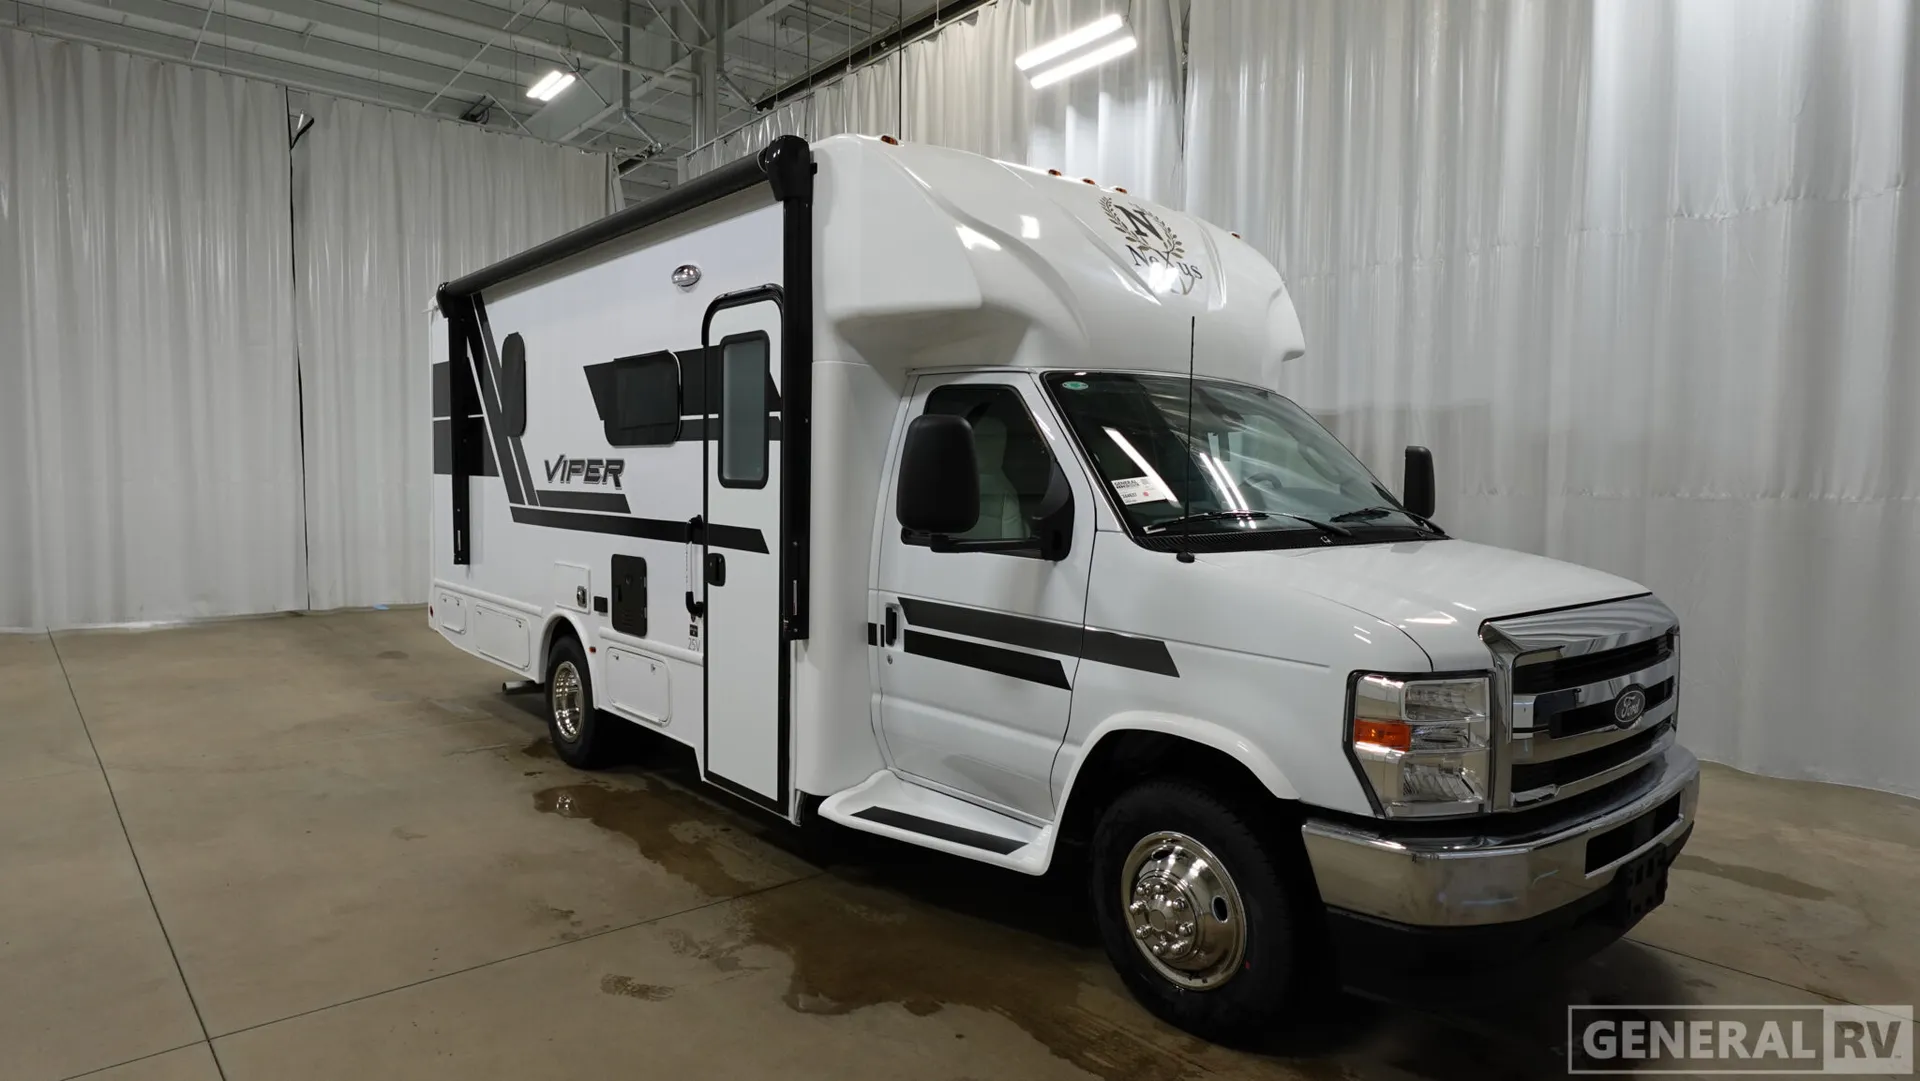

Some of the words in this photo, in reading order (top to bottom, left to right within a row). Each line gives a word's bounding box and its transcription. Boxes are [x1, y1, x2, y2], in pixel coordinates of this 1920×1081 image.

[1113, 204, 1164, 241] N
[543, 454, 625, 490] VIPER
[1621, 695, 1641, 719] Ford
